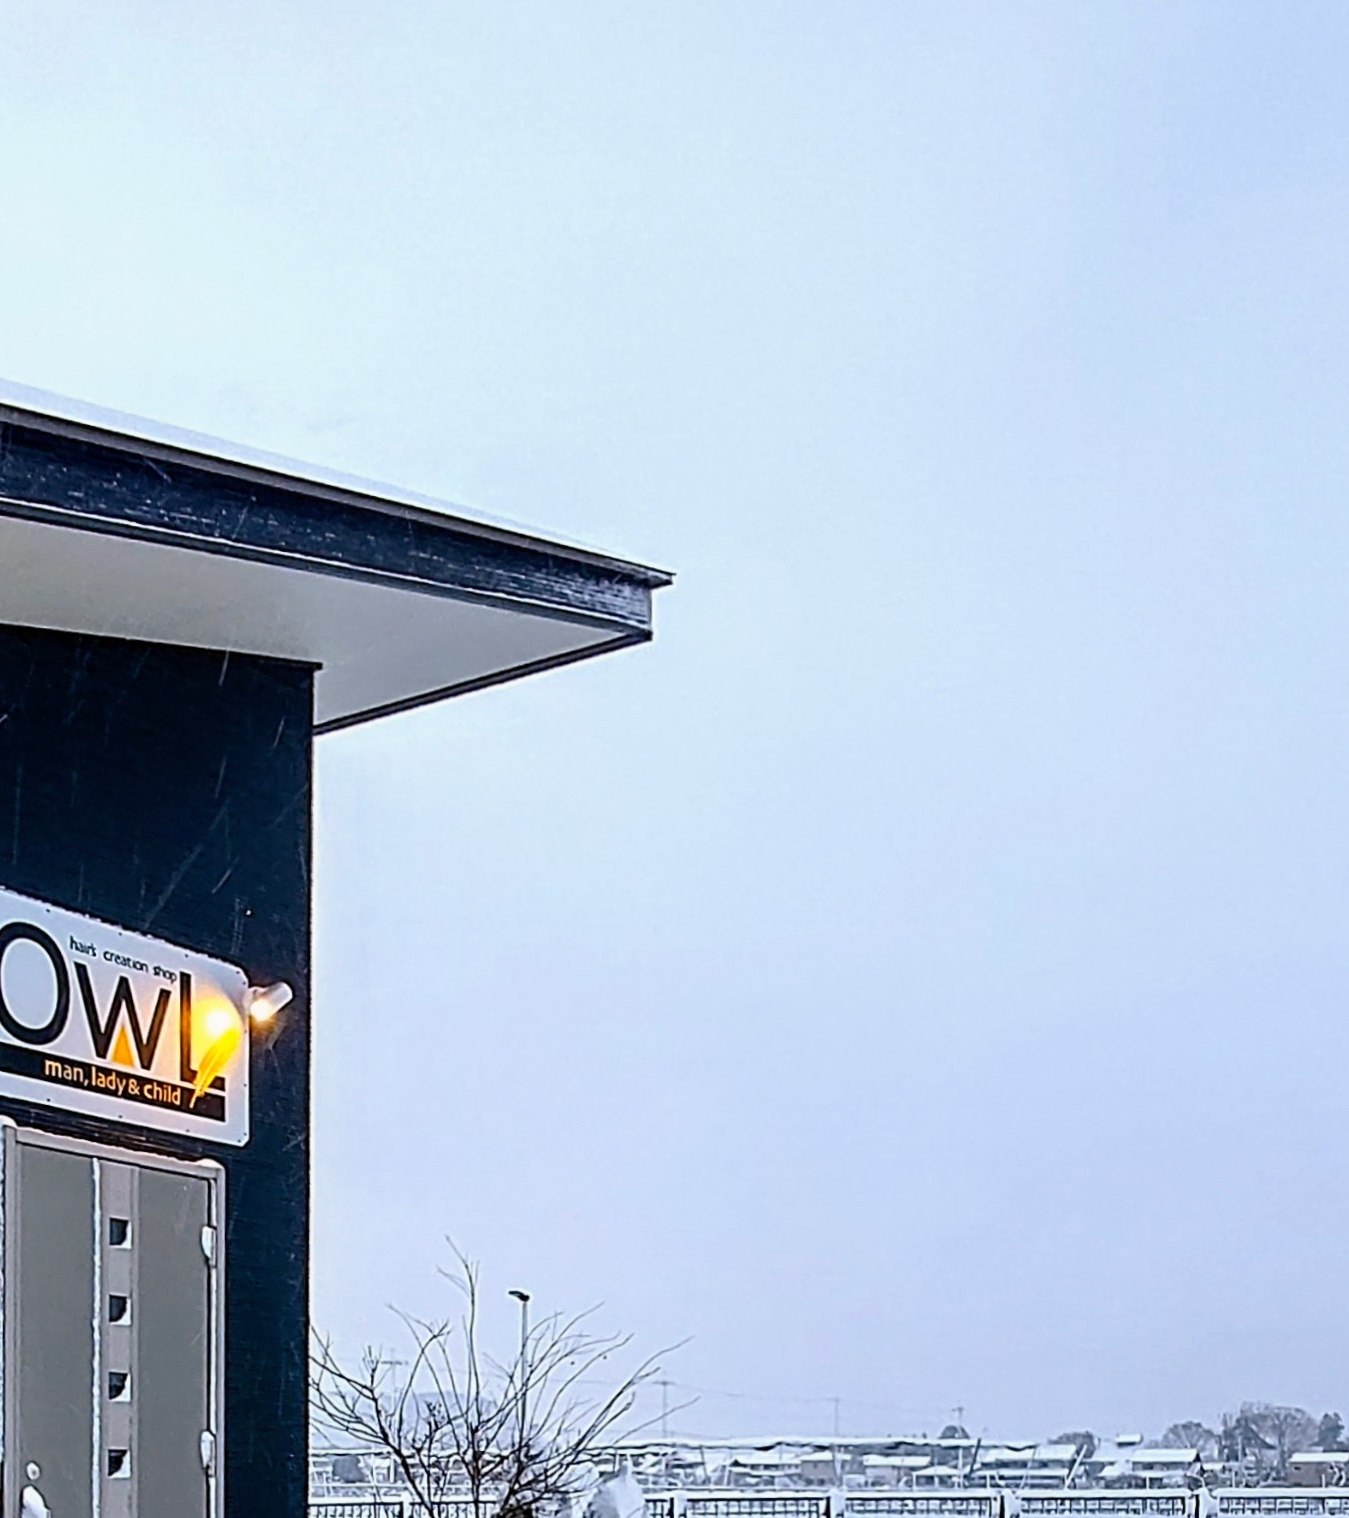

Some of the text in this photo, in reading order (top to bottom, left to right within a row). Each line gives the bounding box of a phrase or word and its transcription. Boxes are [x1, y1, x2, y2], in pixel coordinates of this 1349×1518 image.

[103, 950, 149, 973] creation
[153, 965, 177, 984] shop
[143, 1082, 181, 1106] child
